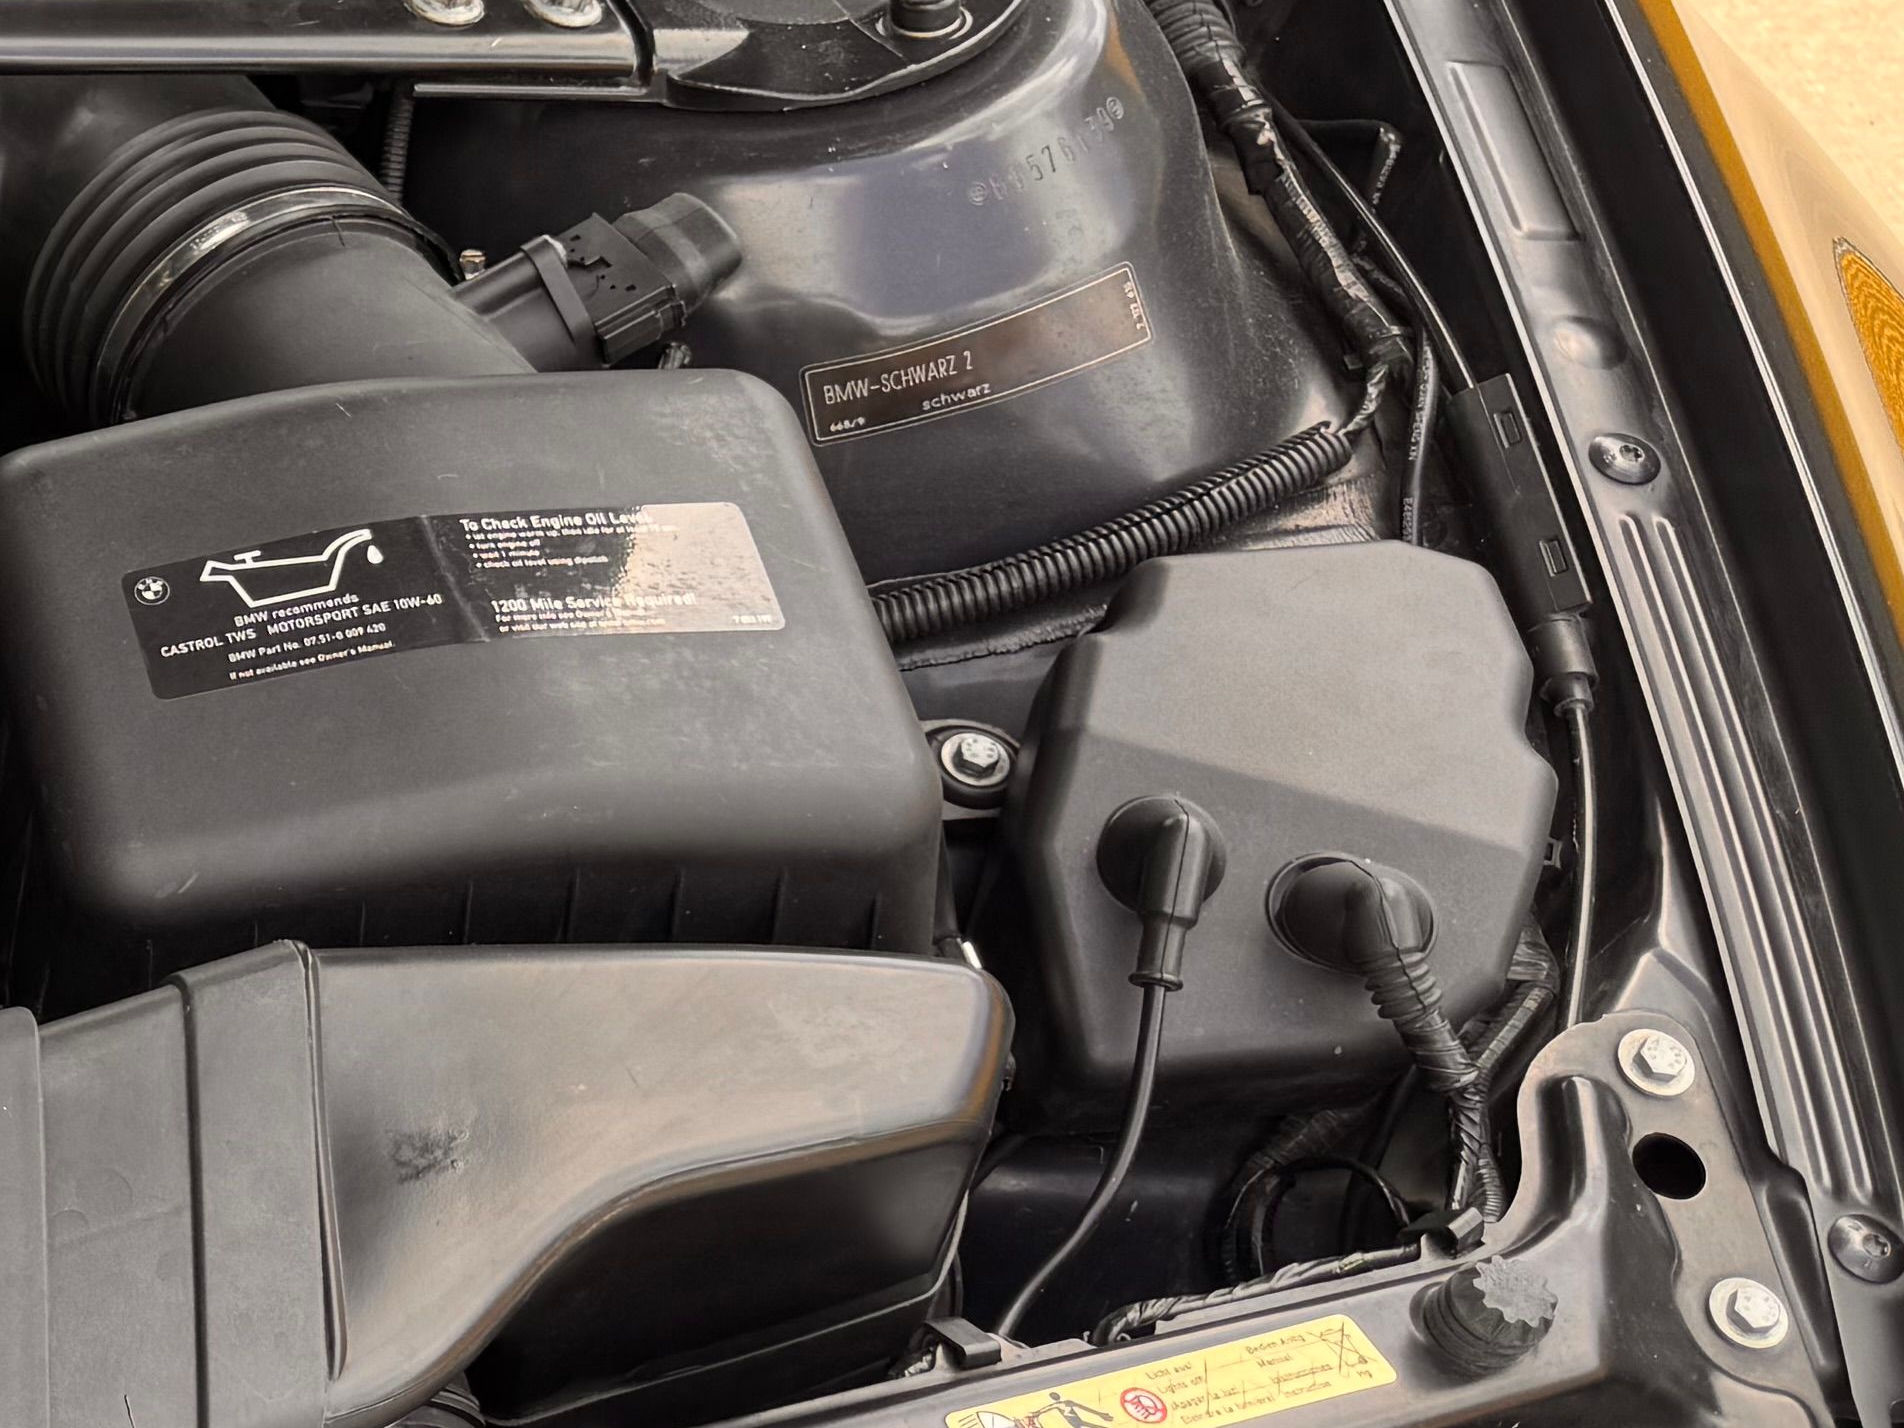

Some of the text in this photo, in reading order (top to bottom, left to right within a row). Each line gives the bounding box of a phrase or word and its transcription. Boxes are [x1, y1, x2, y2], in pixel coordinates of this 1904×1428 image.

[824, 350, 974, 405] BMW-SCHWARZ 2
[922, 382, 991, 411] schwarz
[459, 518, 478, 532] To
[481, 514, 528, 531] Check
[530, 512, 582, 531] Engine
[584, 511, 606, 526] Oil
[234, 593, 360, 628] BMW recommends
[491, 598, 527, 613] 1200
[531, 595, 563, 612] Mile
[566, 594, 620, 610] Service
[160, 593, 443, 658] CASTROL TWS MOTORSPORT SAE 10W-60
